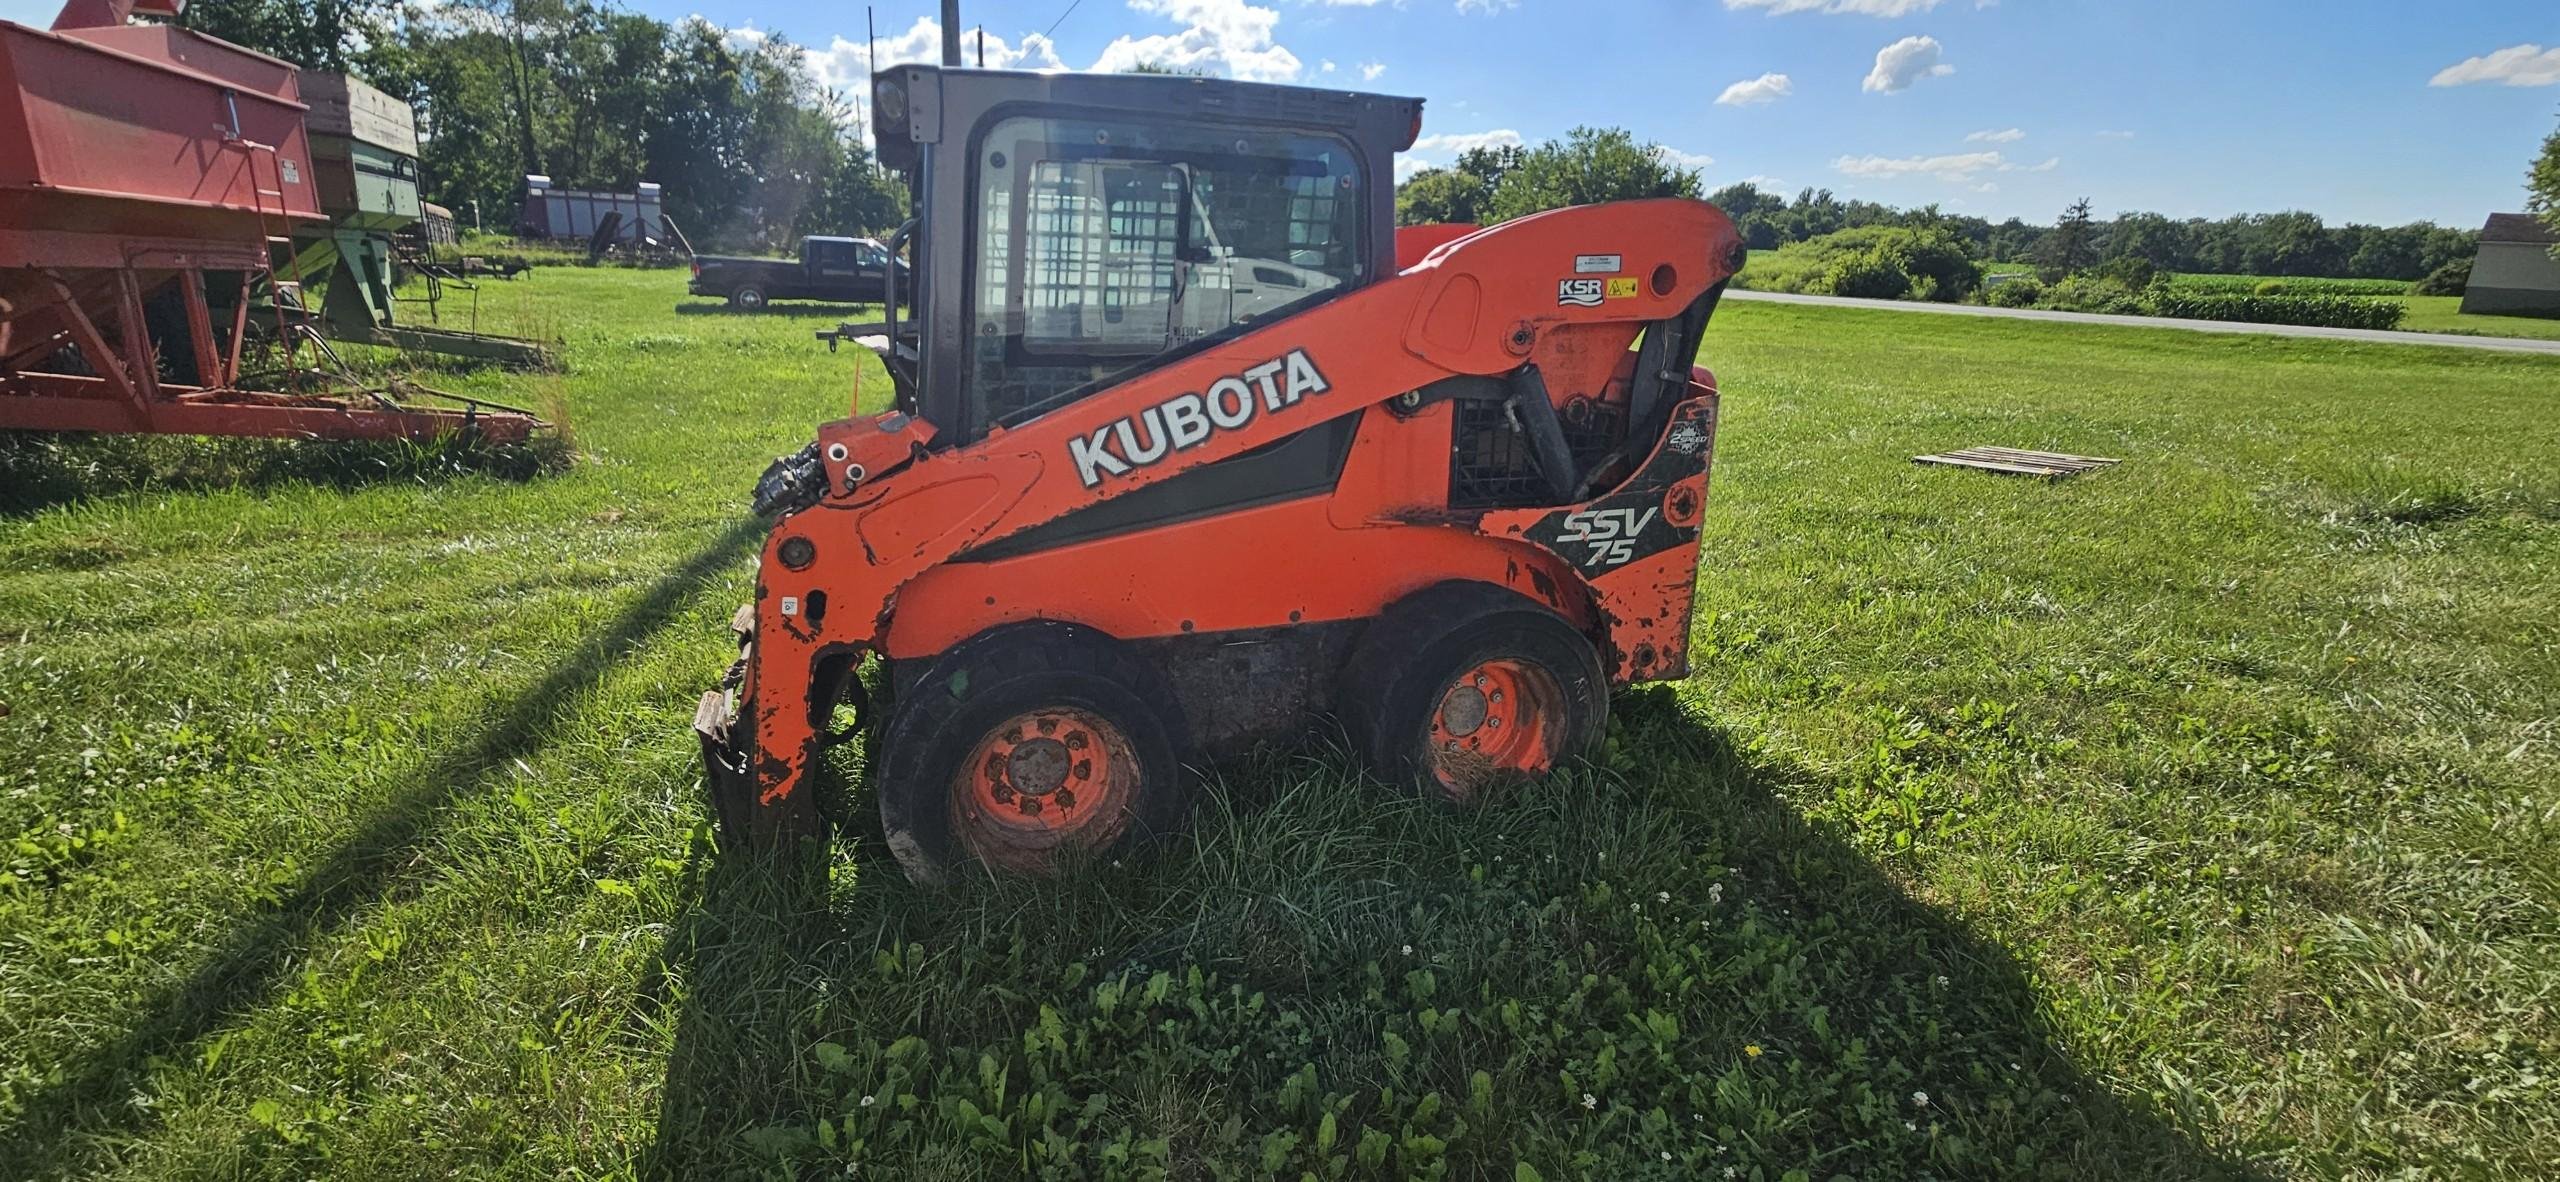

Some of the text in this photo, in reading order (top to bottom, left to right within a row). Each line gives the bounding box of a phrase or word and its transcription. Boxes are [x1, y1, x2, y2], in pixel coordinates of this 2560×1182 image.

[1559, 279, 1602, 295] KSR
[1068, 349, 1328, 487] KUBOTA
[1556, 506, 1659, 542] SSV
[1584, 538, 1637, 567] 75
